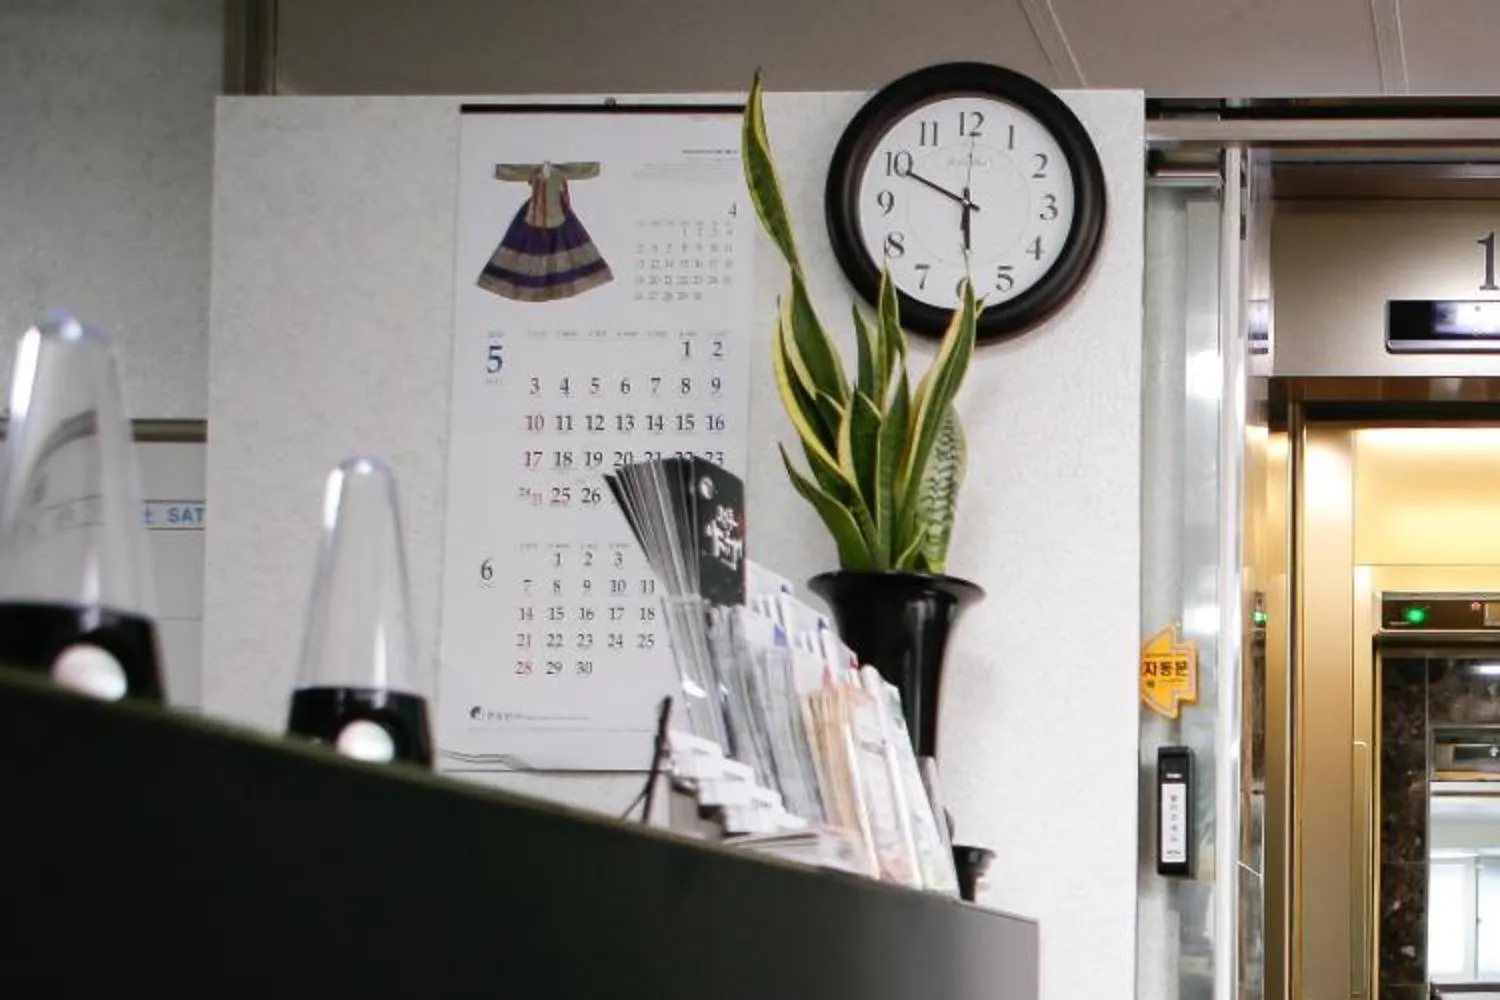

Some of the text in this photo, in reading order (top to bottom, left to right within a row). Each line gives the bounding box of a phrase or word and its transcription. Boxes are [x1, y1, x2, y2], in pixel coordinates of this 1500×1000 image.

[920, 121, 938, 146] 11
[960, 112, 984, 137] 12
[1009, 125, 1014, 149] 1
[885, 150, 914, 178] 10
[1033, 153, 1048, 178] 2
[877, 192, 894, 214] 9
[1040, 194, 1058, 220] 3
[883, 231, 905, 259] 8
[1026, 235, 1045, 261] 4
[1477, 231, 1499, 290] 1
[915, 264, 930, 290] 7
[996, 266, 1014, 290] 5
[487, 345, 503, 374] 5
[681, 341, 723, 358] 1 2
[529, 377, 722, 395] 3 4 5 6 7 8 9
[525, 413, 725, 432] 10 11 12 13 14 15 16
[525, 451, 543, 470] 17
[554, 451, 573, 467] 18
[584, 451, 603, 467] 19
[613, 451, 633, 466] 20
[551, 487, 571, 503] 25
[581, 487, 602, 503] 26
[166, 506, 206, 524] SAT
[480, 559, 494, 581] 6
[553, 551, 623, 568] 1 2 3
[552, 579, 561, 593] 8
[610, 579, 627, 593] 10
[640, 579, 655, 594] 11
[519, 606, 656, 621] 14 15 16 17 18
[515, 633, 655, 649] 21 22 23 24 25
[515, 660, 593, 675] 28 29 30
[1144, 660, 1189, 677] 자동문
